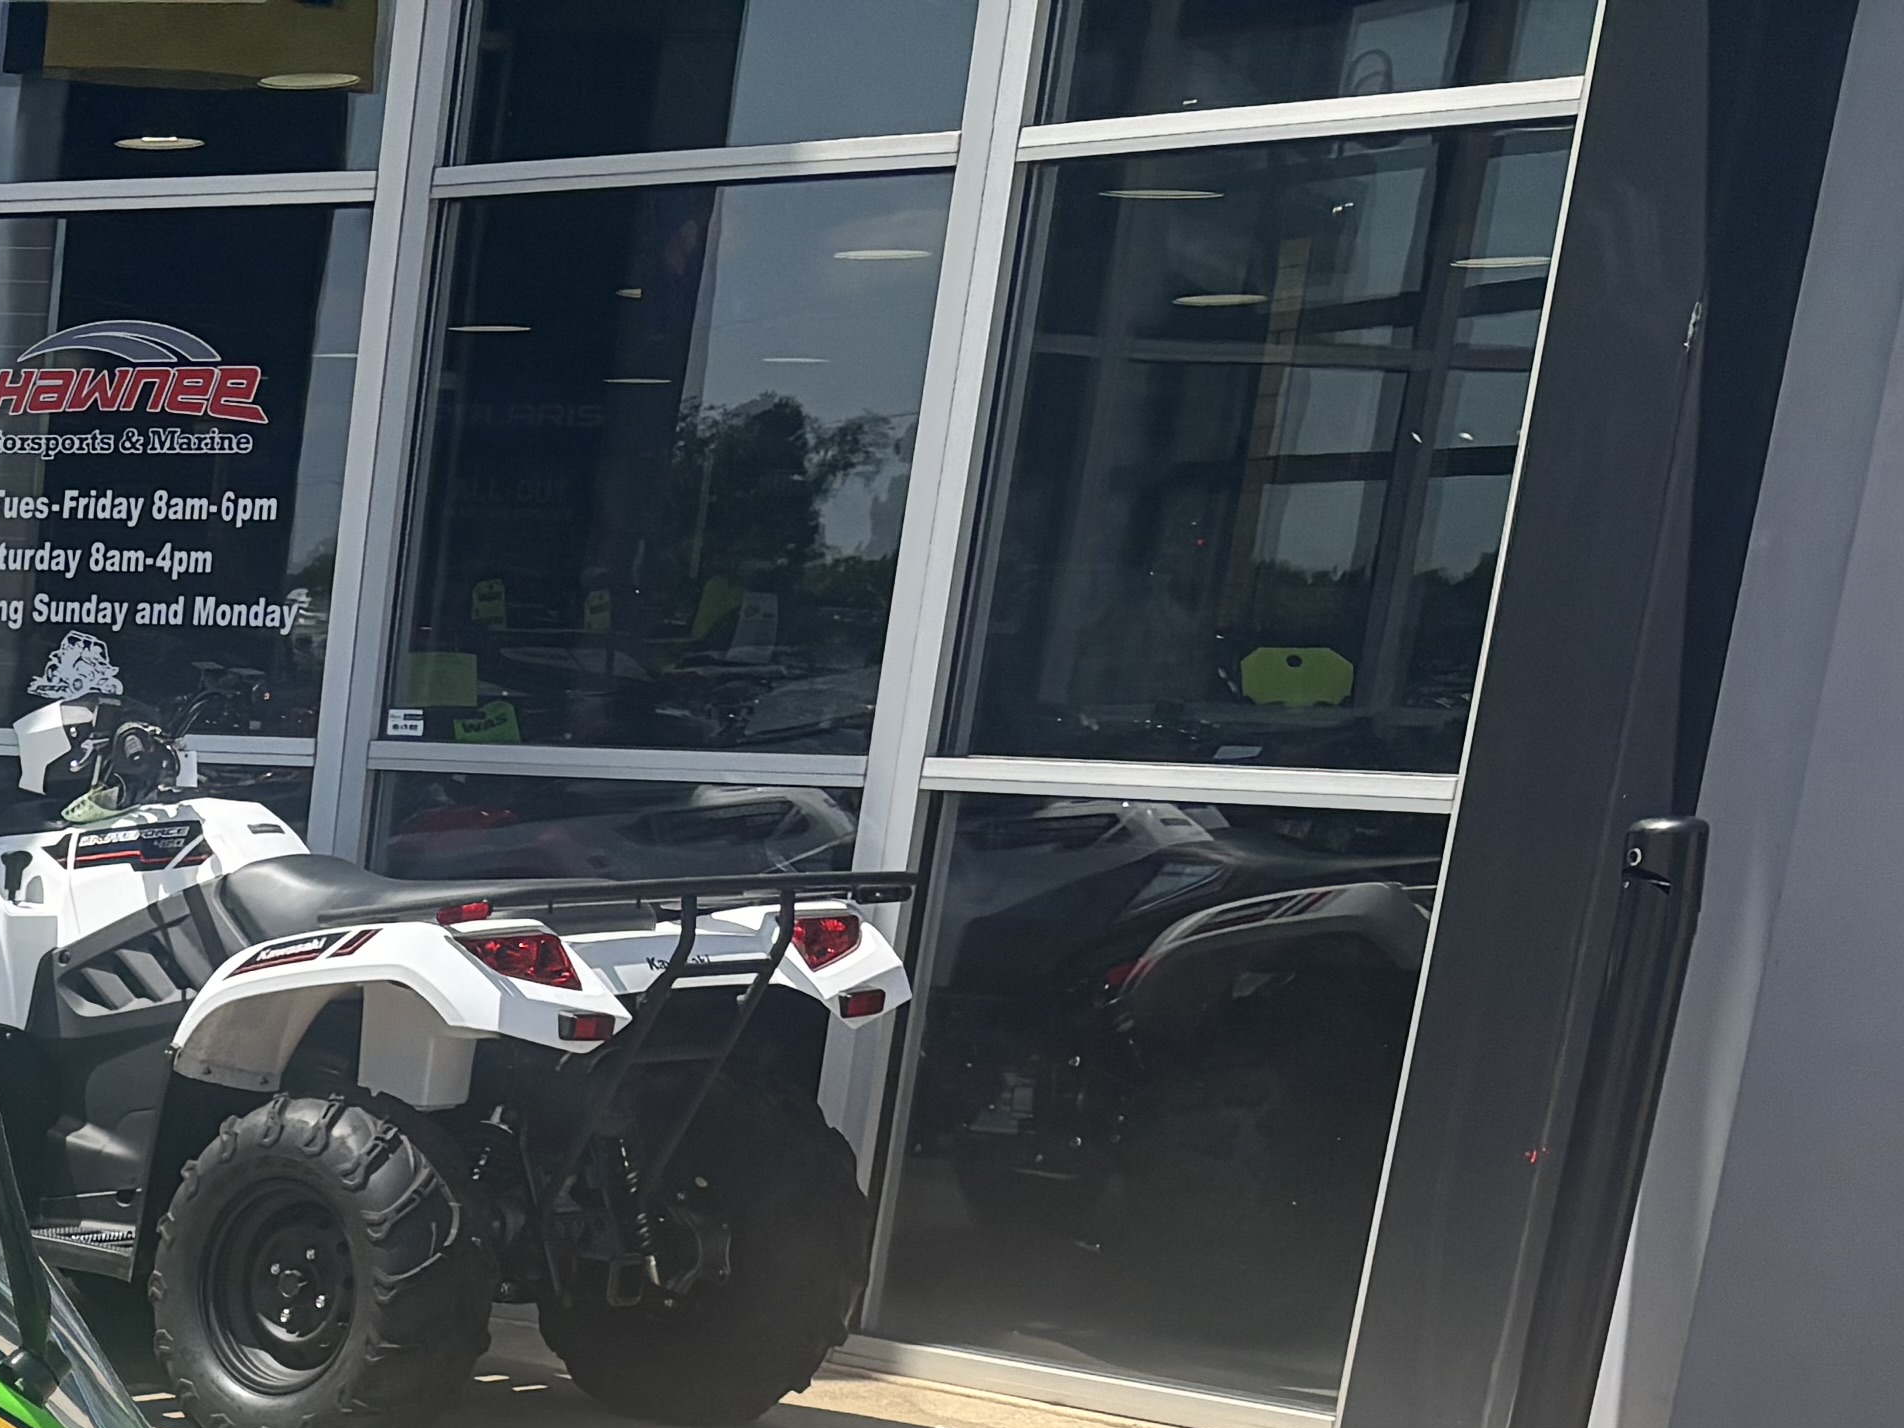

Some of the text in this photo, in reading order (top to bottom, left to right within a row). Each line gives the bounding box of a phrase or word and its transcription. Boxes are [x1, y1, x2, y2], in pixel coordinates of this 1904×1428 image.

[118, 428, 144, 454] &
[147, 427, 253, 454] Marine
[151, 489, 278, 528] 8am-6pm
[89, 542, 213, 580] 8am-4pm
[32, 593, 128, 632] Sunday
[135, 596, 185, 626] and
[192, 596, 299, 635] Monday
[256, 936, 328, 962] Kawasaki
